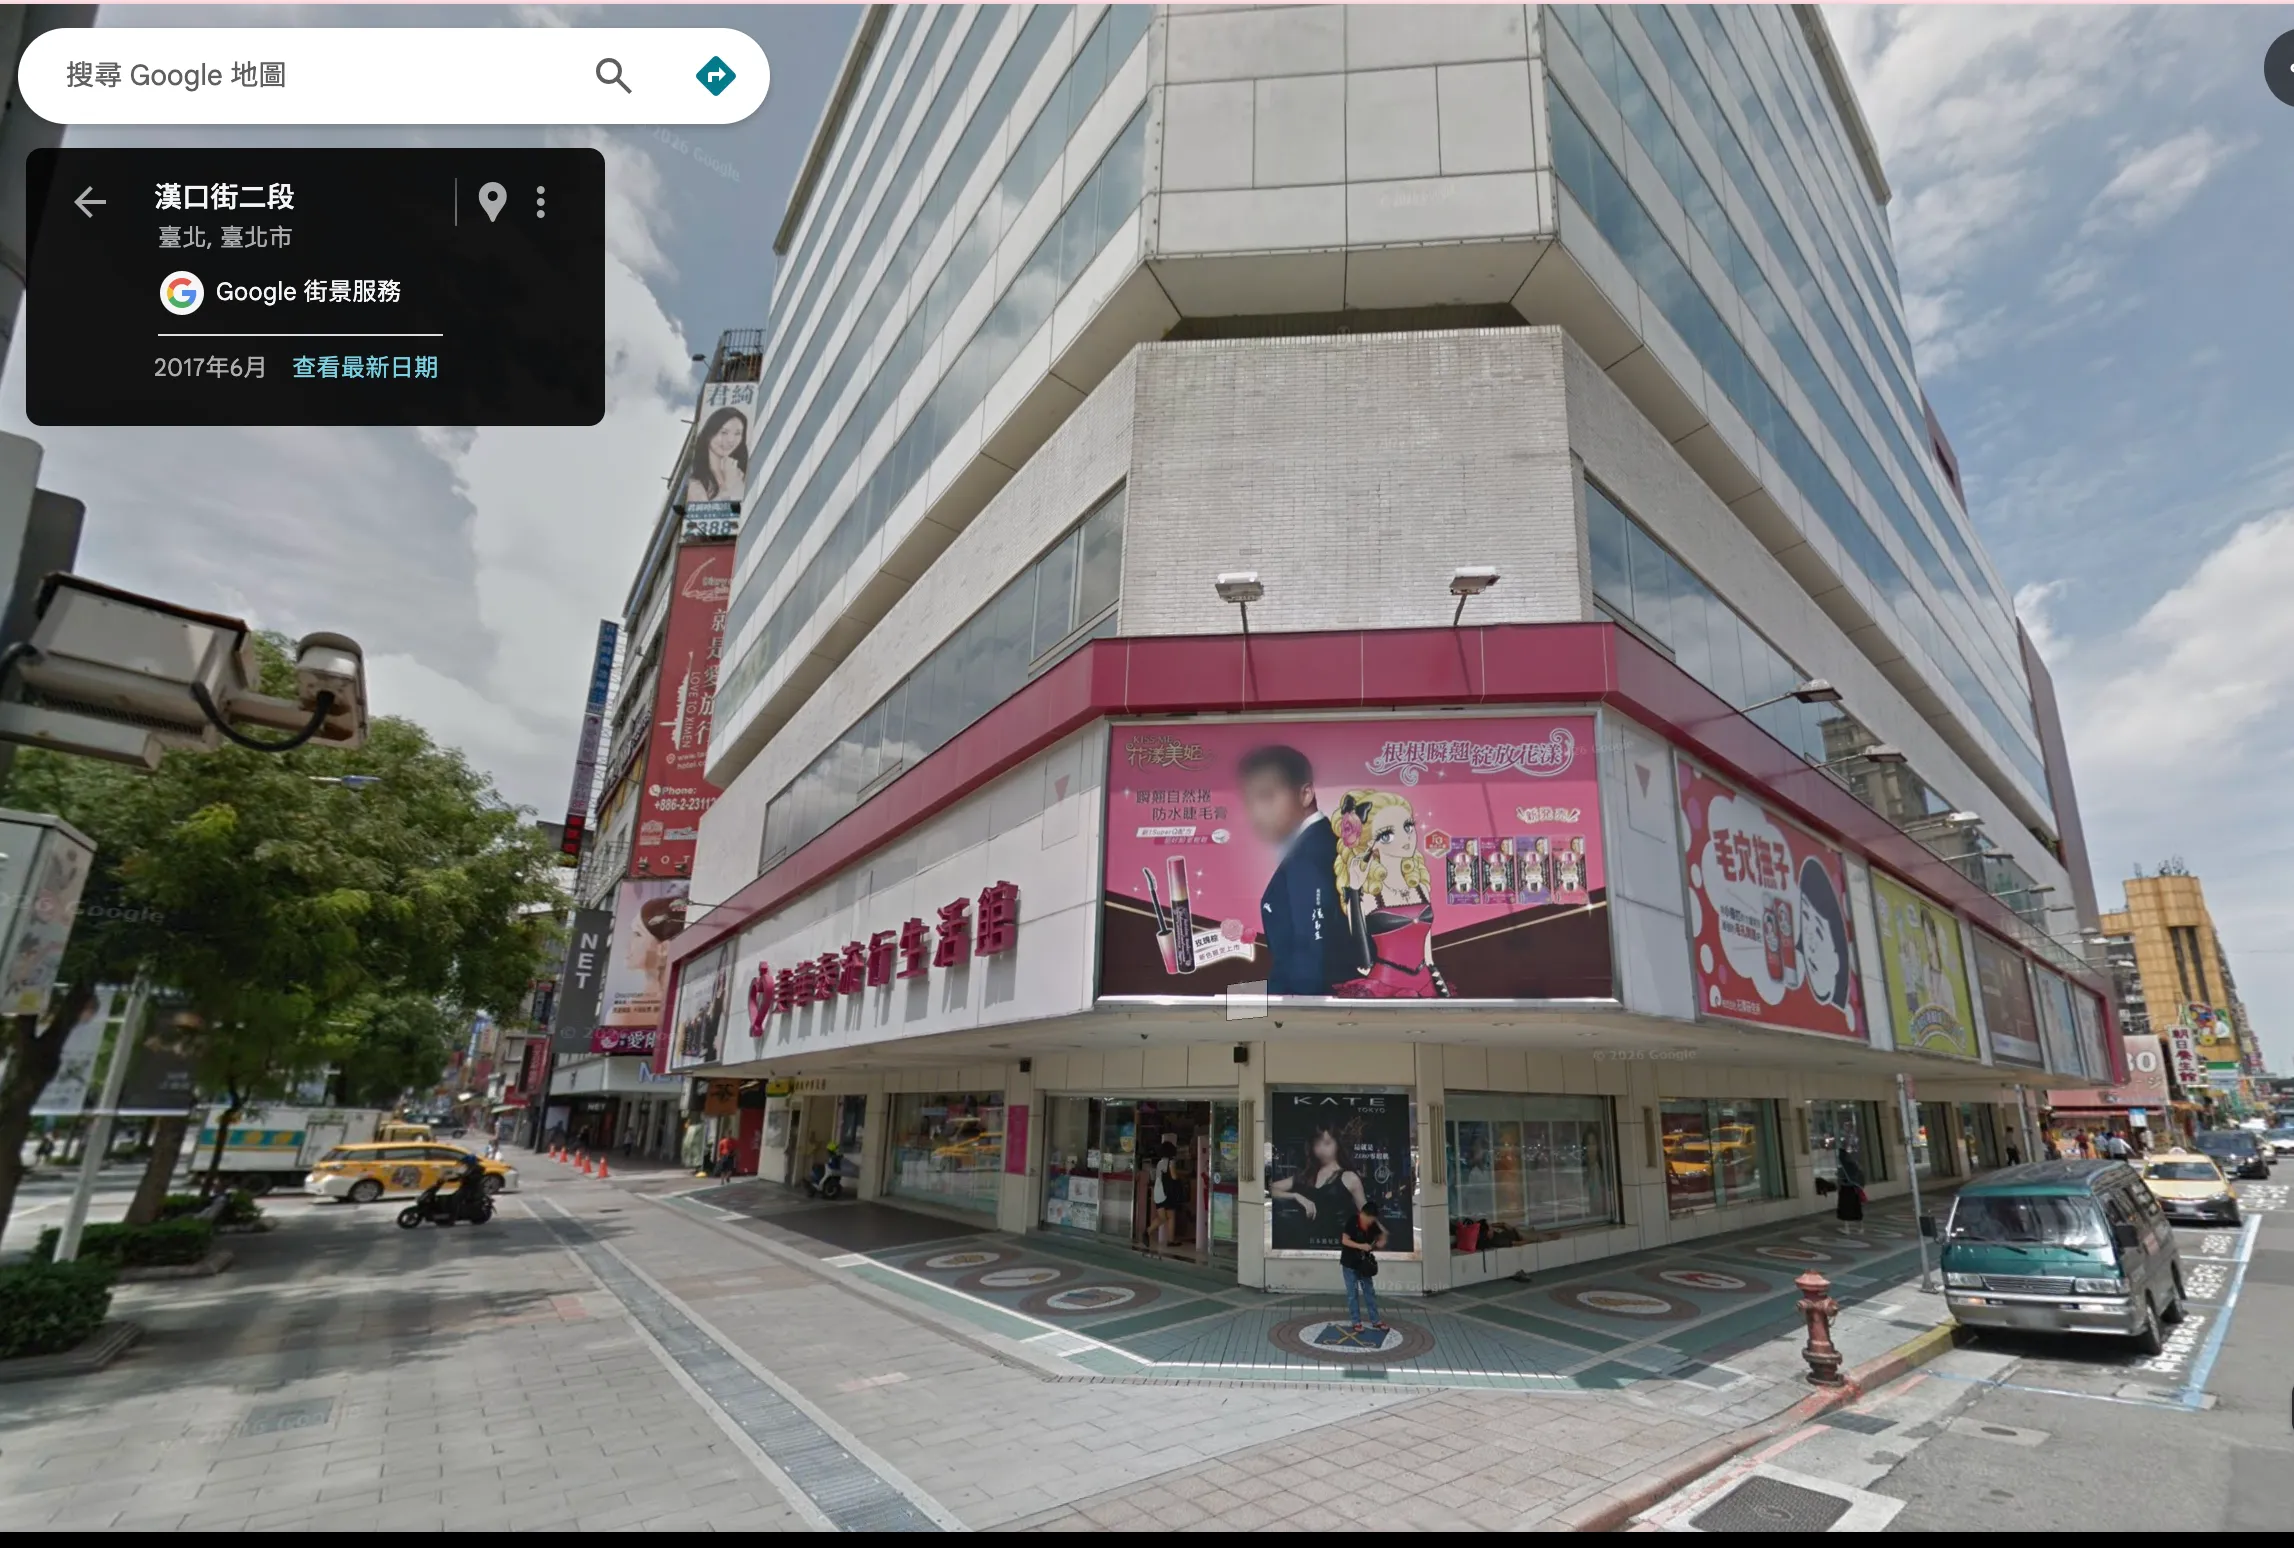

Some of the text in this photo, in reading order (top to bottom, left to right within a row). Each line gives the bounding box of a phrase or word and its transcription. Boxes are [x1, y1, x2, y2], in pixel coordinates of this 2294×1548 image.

[706, 384, 755, 406] 君綺
[682, 671, 701, 749] LOVE TO XIMEN
[661, 786, 697, 796] Phone:
[1712, 828, 1790, 892] 毛穴撫子
[575, 932, 600, 990] NET
[772, 880, 1019, 1014] 美華泰流行生活館
[1294, 1096, 1385, 1107] KATE
